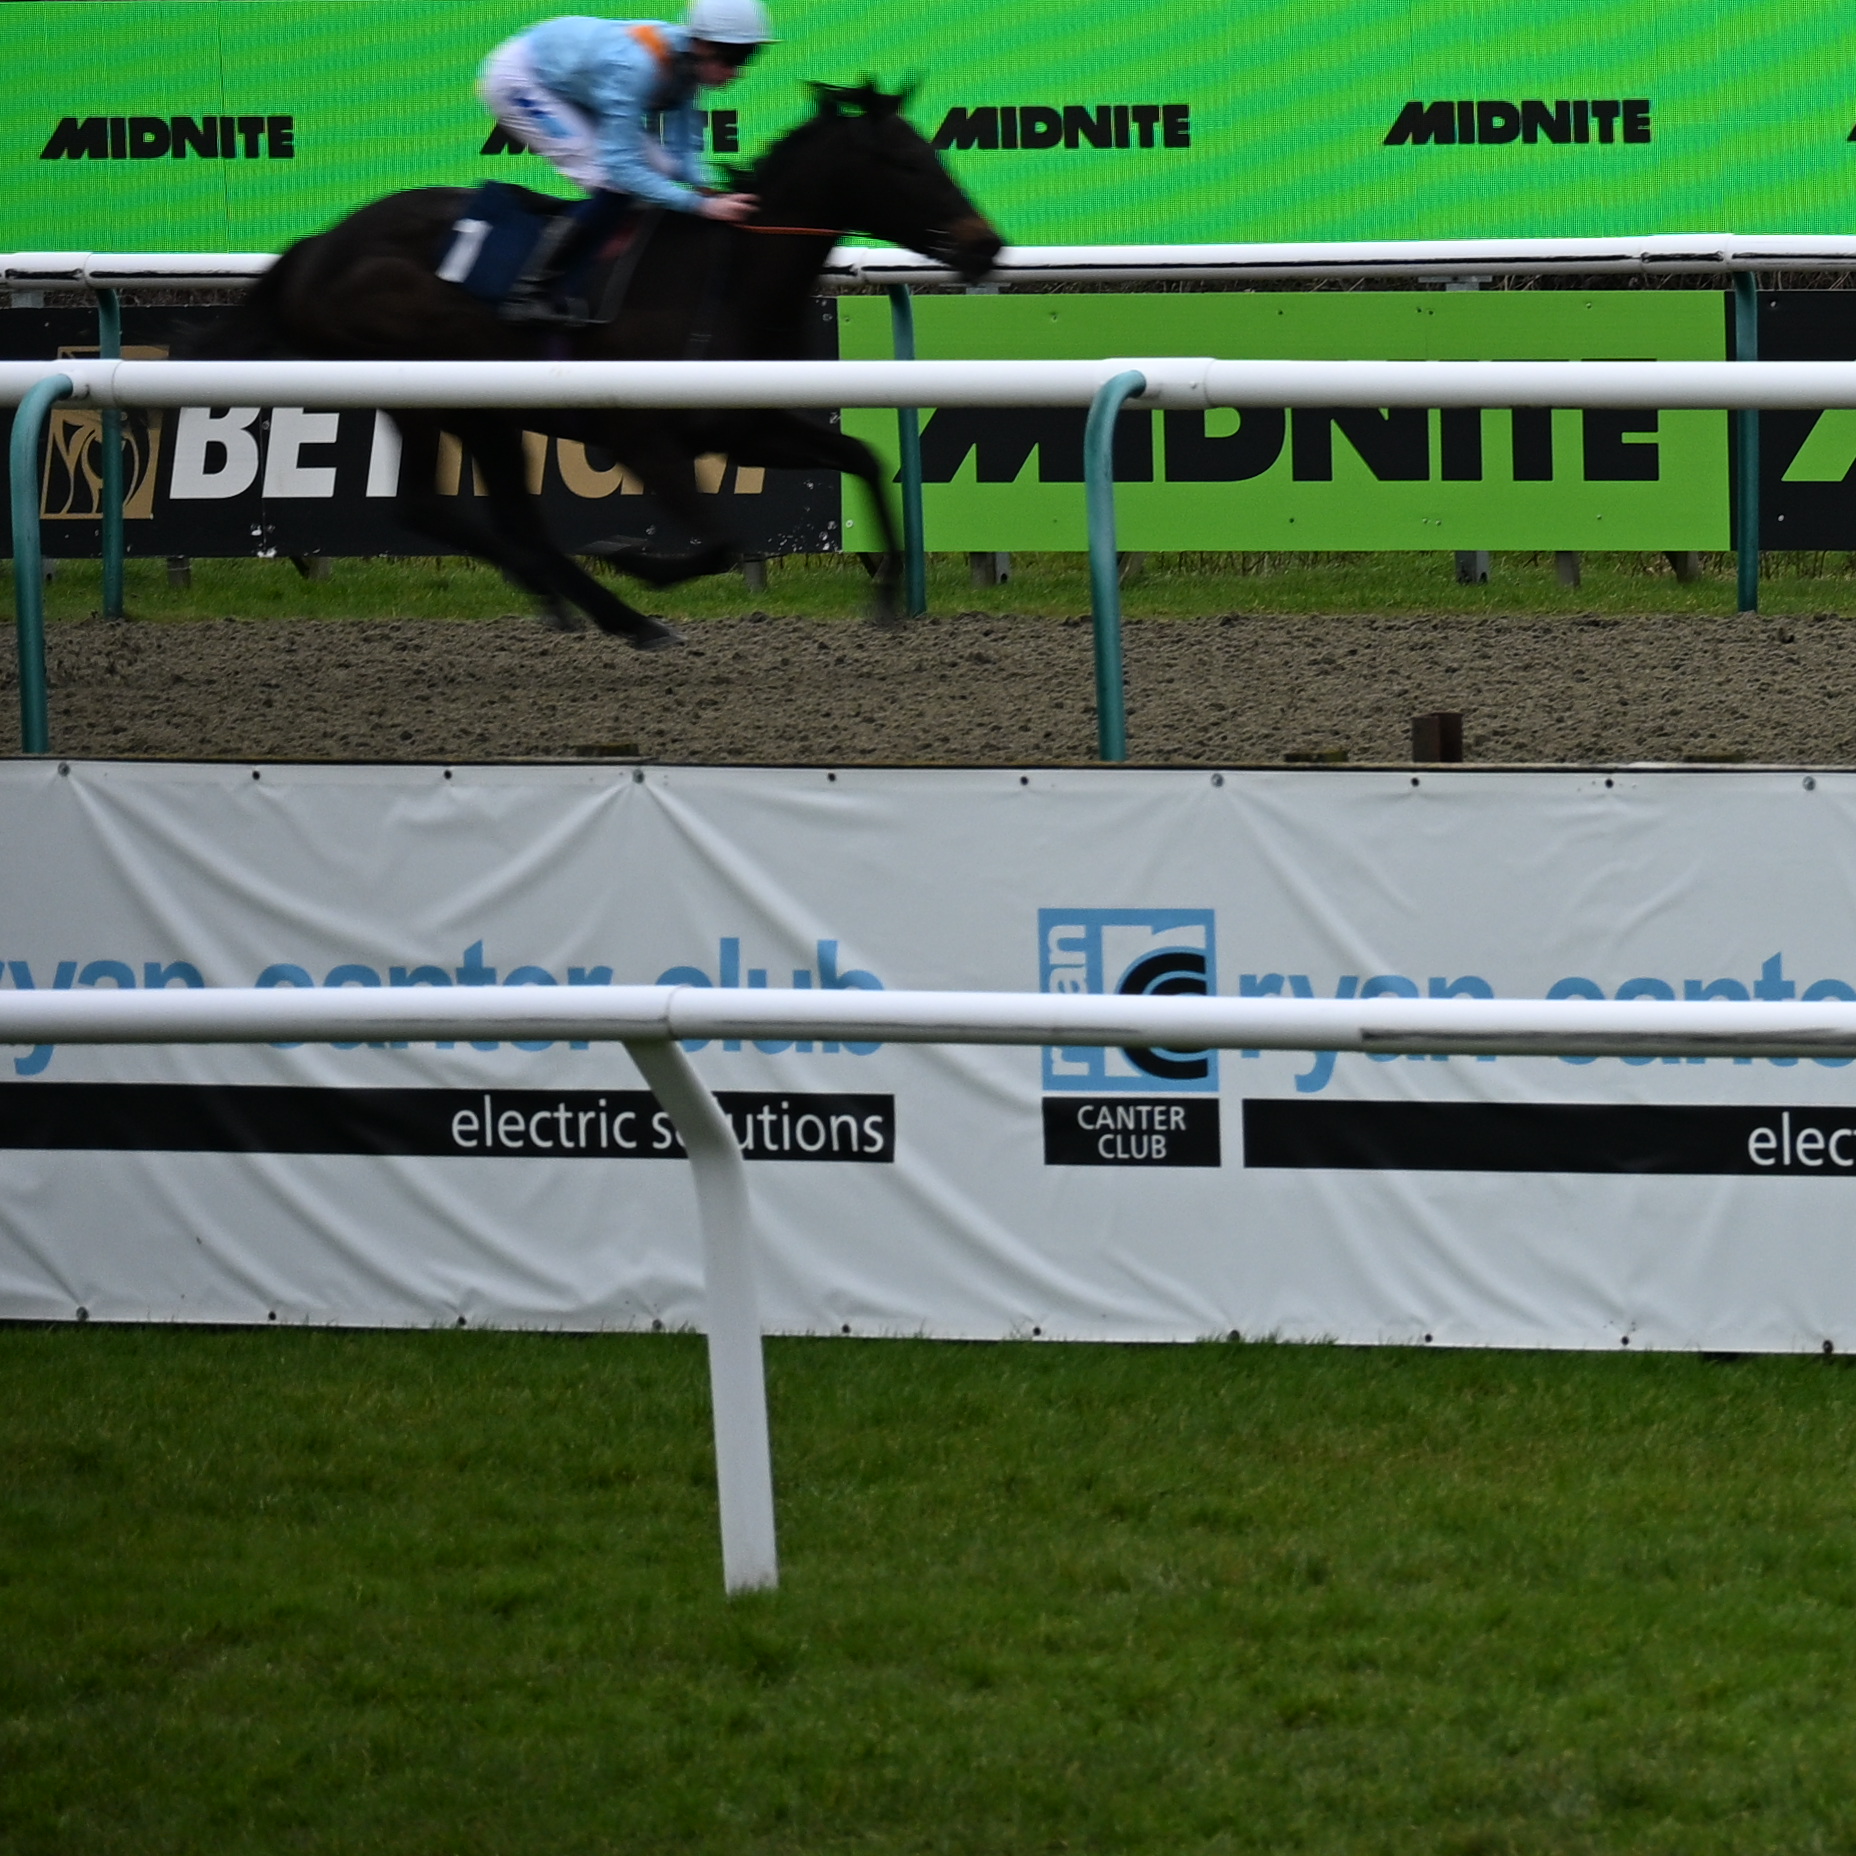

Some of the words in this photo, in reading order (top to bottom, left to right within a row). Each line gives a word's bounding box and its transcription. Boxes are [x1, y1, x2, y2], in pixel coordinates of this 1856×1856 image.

[40, 114, 295, 161] MIDNITE
[929, 103, 1192, 150] MIDNITE
[1383, 98, 1652, 146] MIDNITE
[435, 218, 494, 284] 1
[892, 357, 1660, 483] MIDNITE
[0, 960, 206, 1076] yn
[451, 1093, 638, 1149] electric
[651, 1100, 885, 1154] sutions
[1076, 1104, 1187, 1132] CANTER
[1097, 1133, 1168, 1160] CLUB
